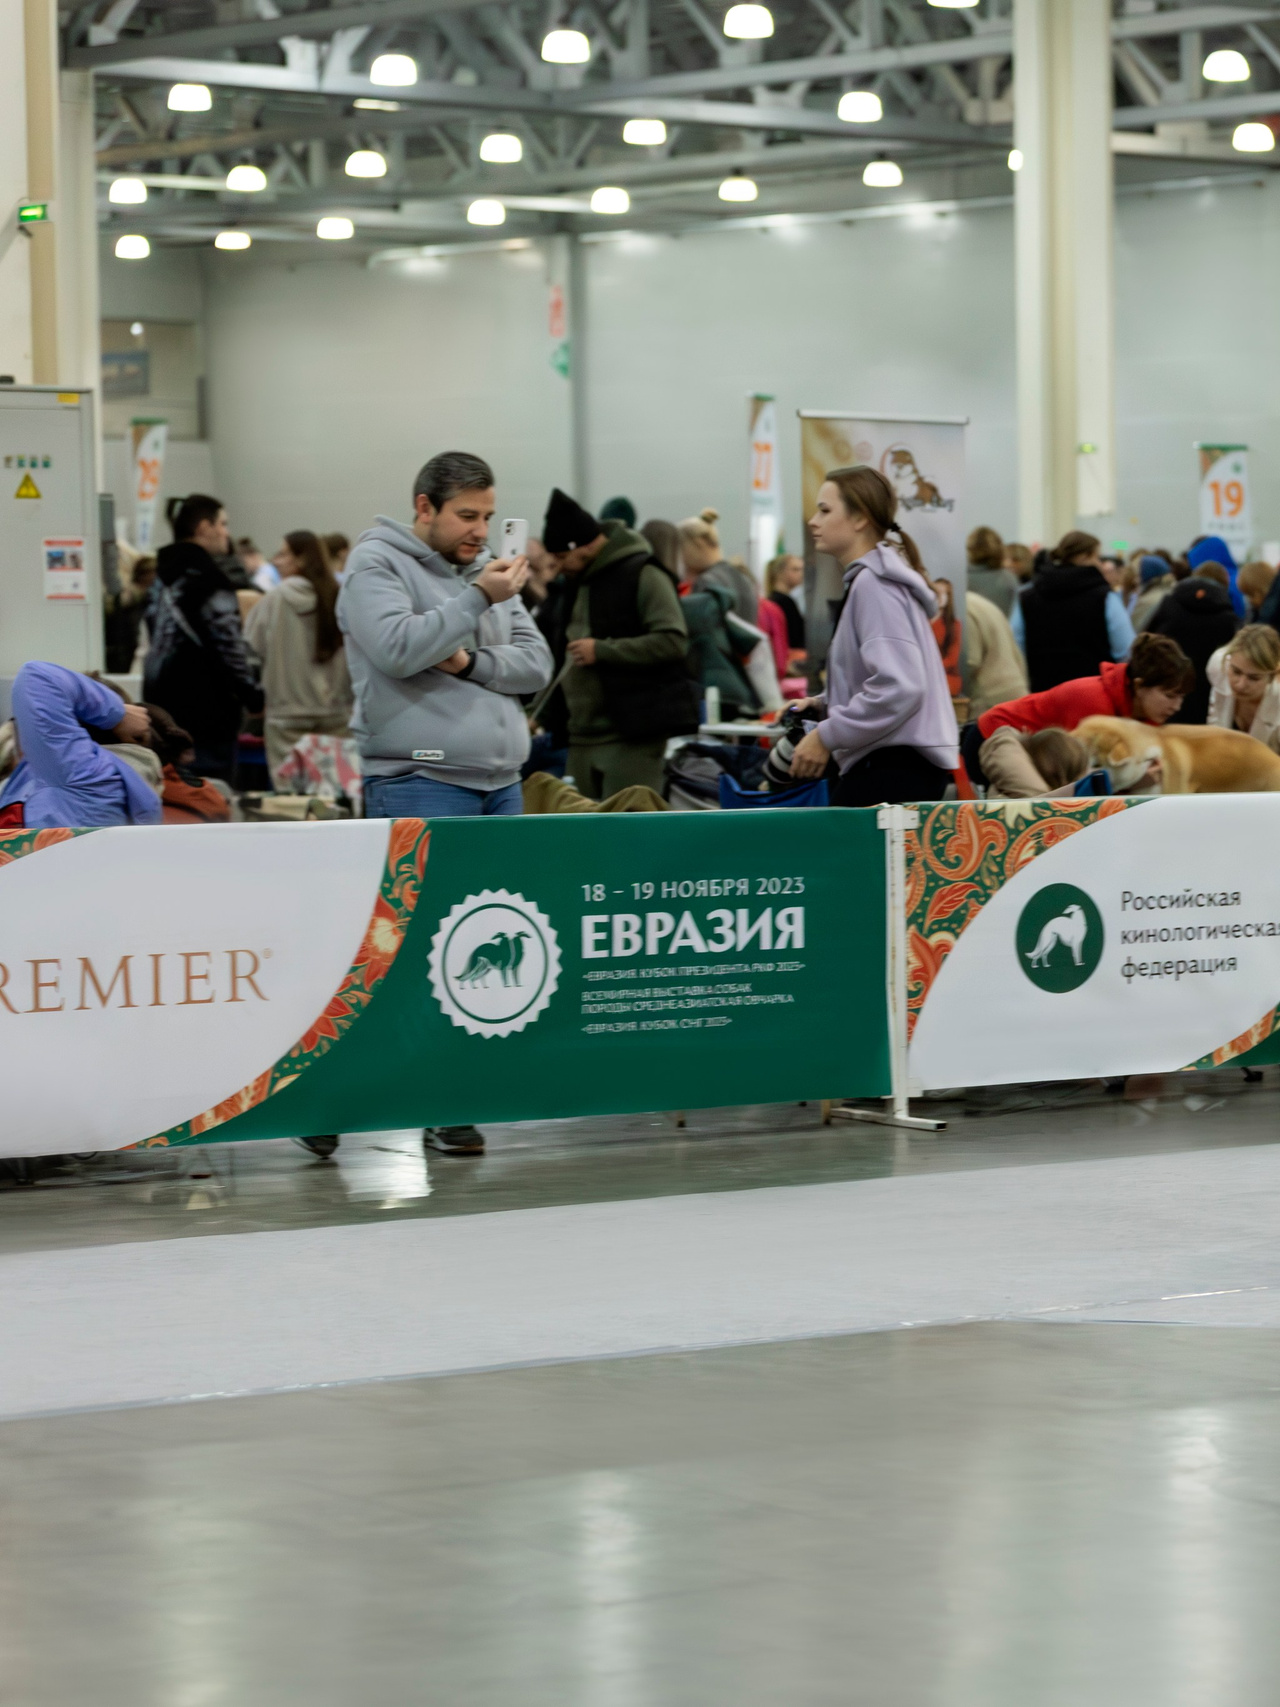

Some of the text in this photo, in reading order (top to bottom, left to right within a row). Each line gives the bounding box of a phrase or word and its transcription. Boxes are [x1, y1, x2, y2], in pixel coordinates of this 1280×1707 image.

[1208, 481, 1244, 517] 19
[581, 884, 606, 902] 18
[631, 882, 655, 900] 19
[661, 878, 750, 899] НОЯБРЯ
[756, 876, 805, 896] 2023
[1121, 888, 1242, 911] Российская
[581, 906, 805, 959] ЕВРАЗИЯ
[1121, 956, 1238, 984] федерация
